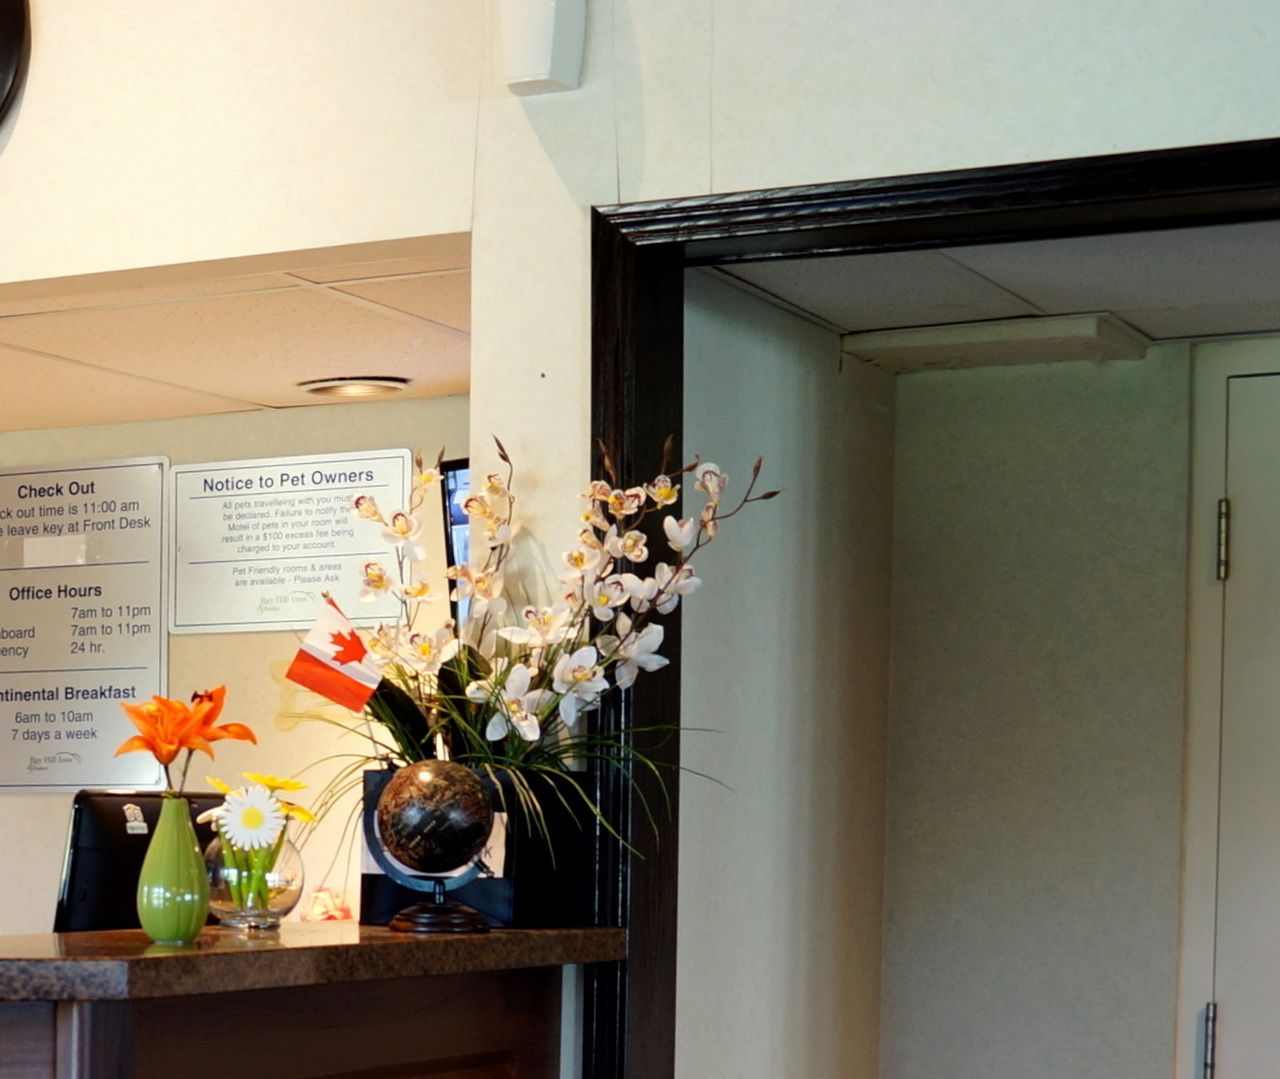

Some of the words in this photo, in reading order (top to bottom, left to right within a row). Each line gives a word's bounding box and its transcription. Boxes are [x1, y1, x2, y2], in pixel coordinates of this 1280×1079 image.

[204, 477, 253, 492] Notice
[259, 476, 274, 488] to
[281, 473, 305, 486] Pet
[312, 471, 373, 484] Owners
[18, 483, 63, 499] Check
[69, 480, 96, 496] Out
[16, 507, 35, 518] out
[39, 506, 64, 517] time
[69, 504, 78, 515] is
[83, 501, 116, 513] 11:00
[120, 502, 140, 512] am
[222, 501, 233, 510] All
[233, 501, 252, 511] pets
[297, 496, 314, 505] with
[316, 496, 332, 506] you
[274, 508, 303, 518] Failure
[315, 506, 337, 516] notify
[7, 525, 39, 536] leave
[43, 523, 63, 536] key
[68, 522, 78, 532] at
[84, 519, 115, 531] Front
[120, 517, 150, 529] Desk
[228, 522, 250, 532] Motel
[251, 521, 262, 531] of
[262, 522, 278, 531] pets
[291, 520, 308, 529] your
[310, 518, 333, 527] room
[334, 516, 348, 525] will
[221, 534, 244, 544] result
[262, 530, 284, 540] $100
[285, 530, 314, 539] excess
[315, 529, 329, 538] fee
[330, 528, 355, 538] being
[237, 544, 269, 554] charged
[281, 543, 301, 553] your
[232, 566, 247, 576] Pet
[247, 565, 281, 575] Friendly
[282, 565, 308, 573] rooms
[318, 563, 343, 572] areas
[234, 579, 248, 587] are
[249, 576, 286, 586] available
[293, 574, 322, 584] Please
[324, 573, 340, 583] Ask
[9, 586, 52, 600] Office
[58, 585, 101, 598] Hours
[72, 607, 96, 618] 7am
[101, 607, 112, 617] to
[118, 605, 150, 619] 11pm
[71, 625, 96, 636] 7am
[101, 624, 112, 635] to
[118, 623, 150, 636] 11pm
[71, 642, 85, 653] 24
[90, 642, 104, 652] hr.
[65, 686, 135, 700] Breakfast
[15, 712, 40, 723] 6am
[45, 712, 56, 723] to
[61, 711, 93, 722] 10am
[11, 729, 18, 740] 7
[23, 729, 50, 743] days
[54, 730, 62, 740] a
[66, 728, 96, 739] week
